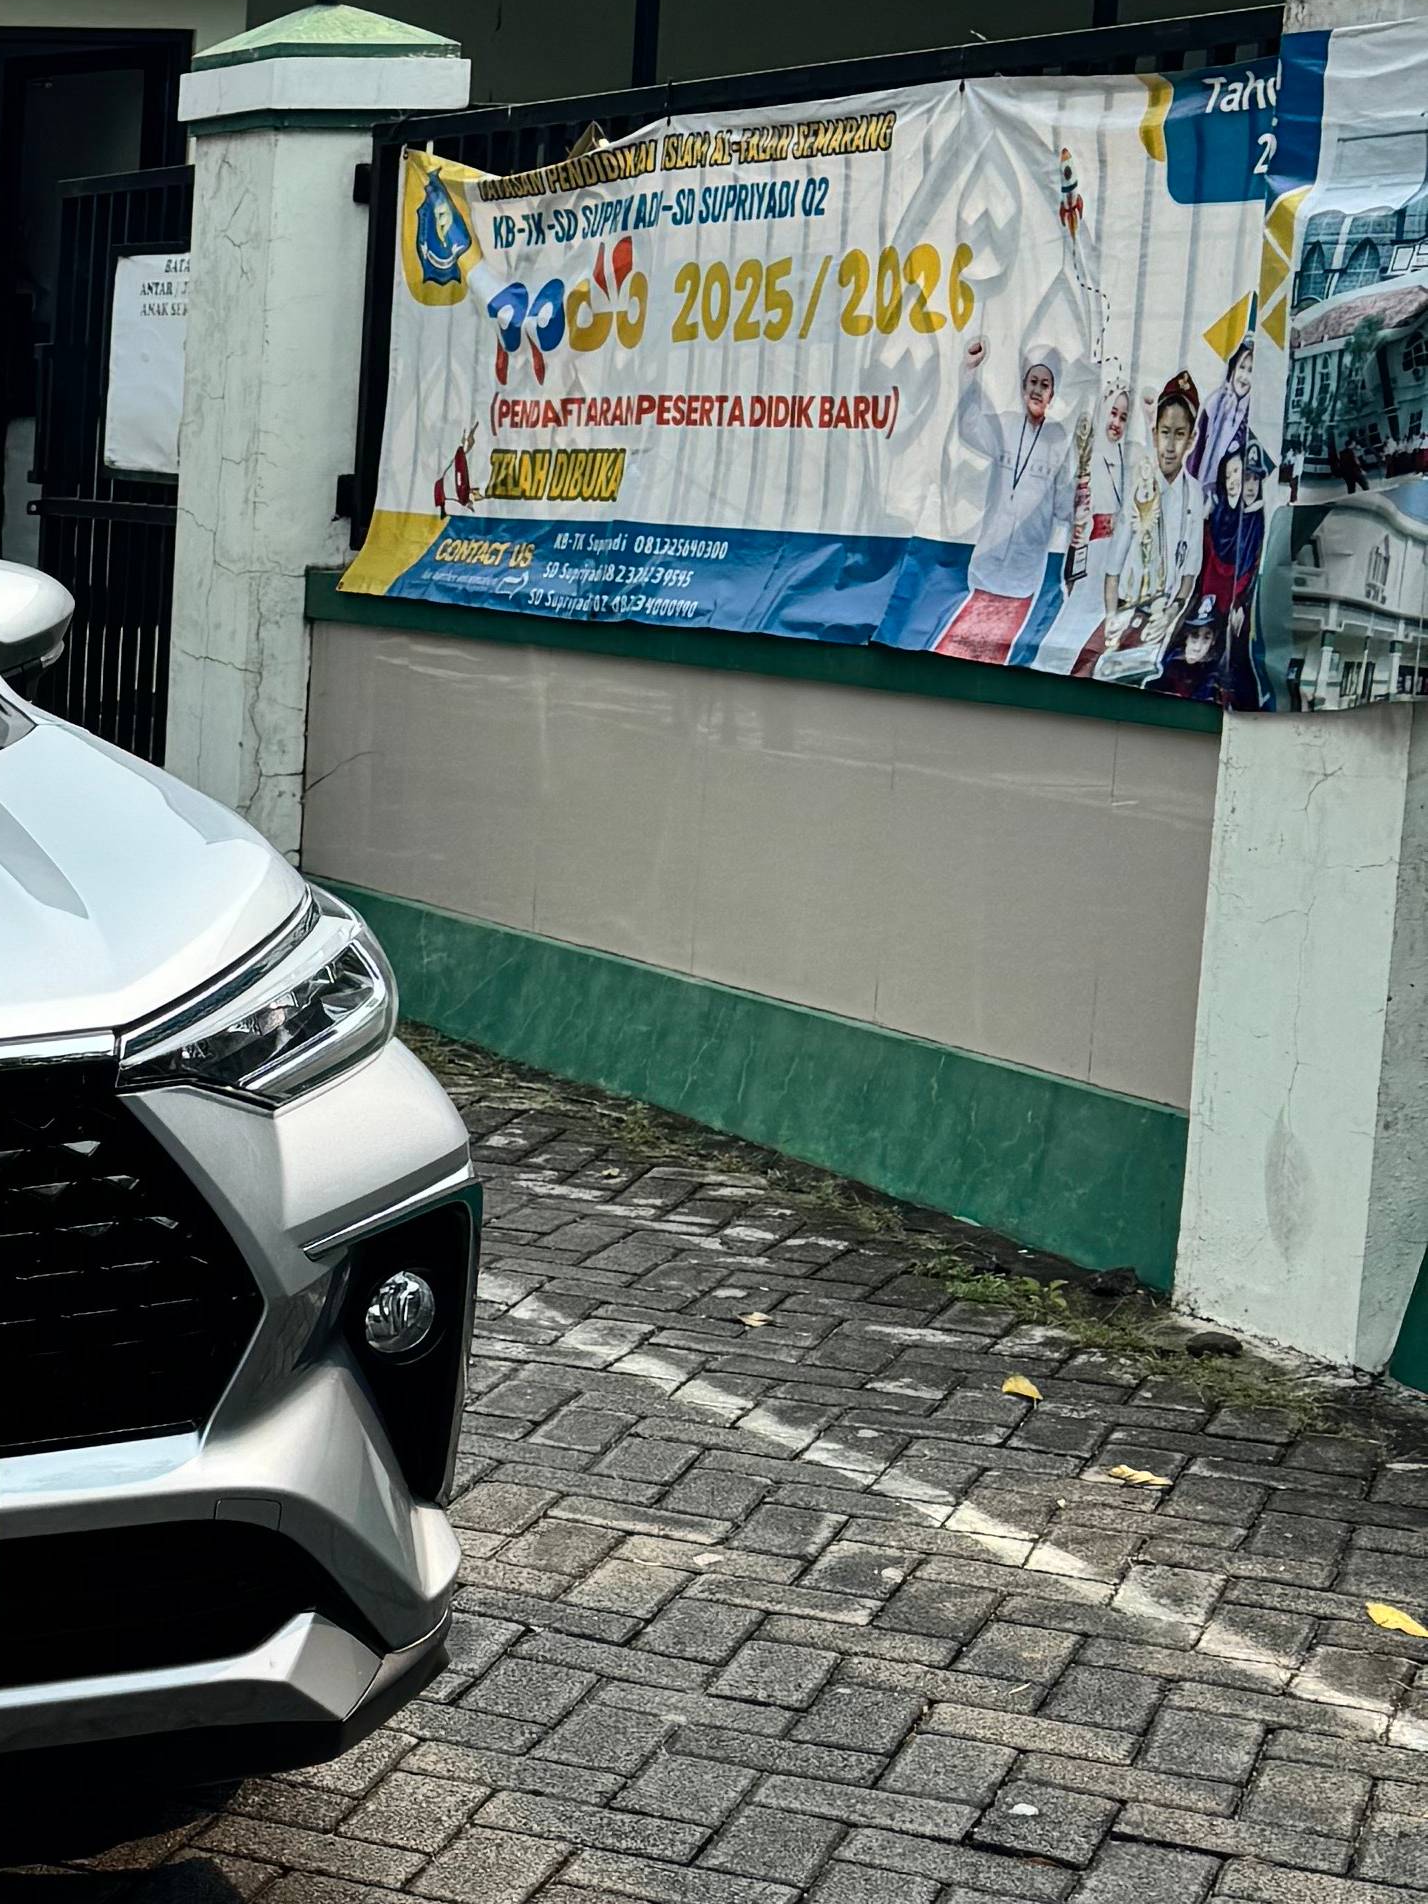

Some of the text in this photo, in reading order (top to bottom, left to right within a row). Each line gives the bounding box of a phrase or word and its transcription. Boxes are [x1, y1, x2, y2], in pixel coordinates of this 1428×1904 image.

[661, 130, 710, 171] ISLAM
[793, 111, 896, 160] SEMARANG
[699, 179, 800, 224] SUPRIYADI
[802, 176, 830, 218] 02
[140, 281, 173, 296] ANTAR
[140, 302, 169, 316] ANAK
[634, 394, 745, 427] PESERTA
[748, 394, 815, 428] DIDIK
[817, 386, 900, 439] BARU)
[485, 448, 627, 502] TELAH DIBUKA
[435, 538, 535, 569] CONTACT US
[543, 561, 560, 578] SD
[528, 588, 544, 605] SD
